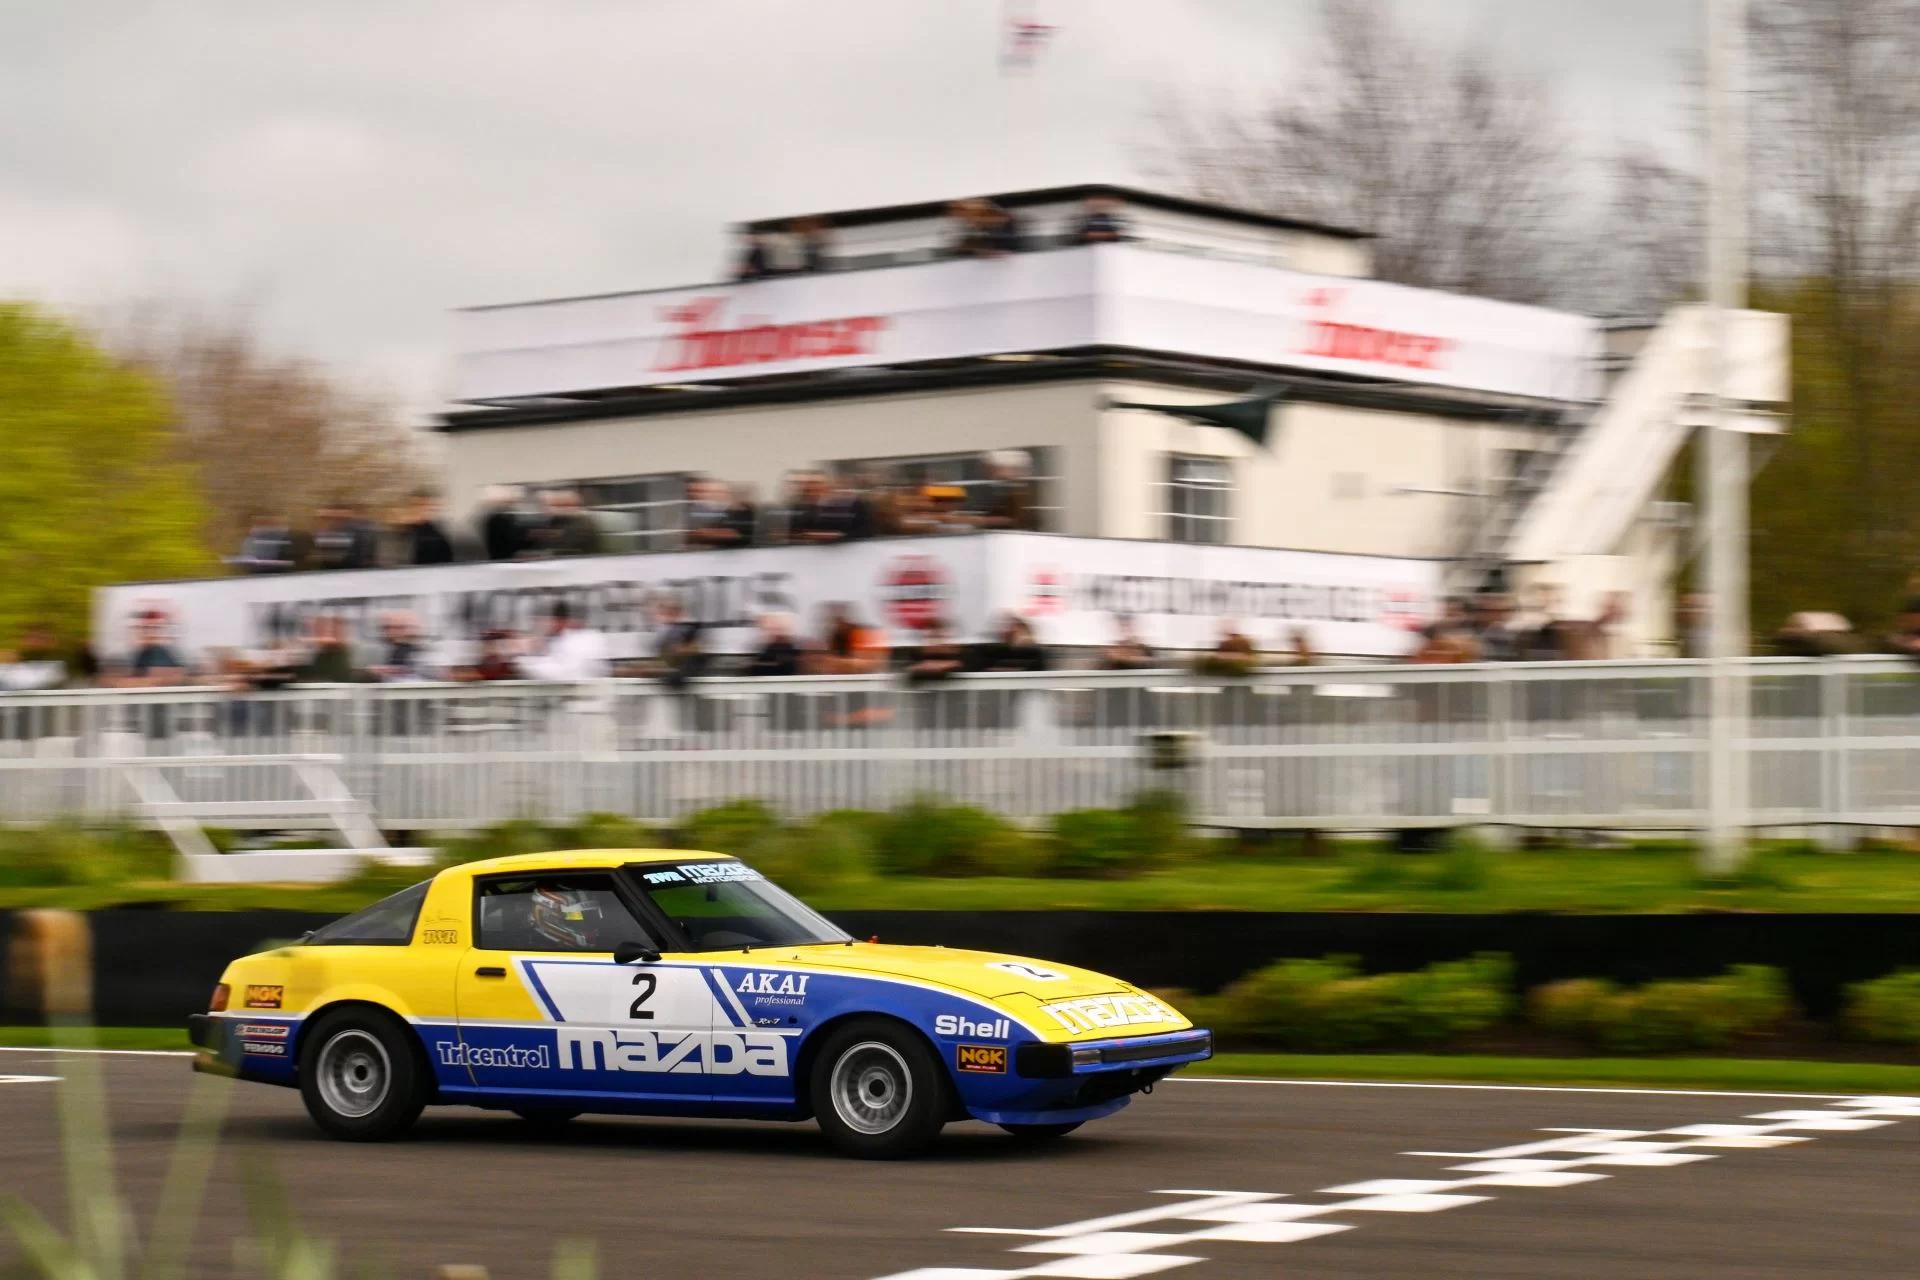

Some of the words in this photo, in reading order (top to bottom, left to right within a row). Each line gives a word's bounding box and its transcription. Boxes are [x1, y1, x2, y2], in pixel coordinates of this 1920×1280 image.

[424, 929, 457, 944] TWR
[1001, 963, 1055, 978] 2
[248, 985, 283, 1001] NGK
[737, 972, 809, 995] AKAI
[629, 973, 656, 1019] 2
[755, 995, 804, 1006] professional
[935, 1014, 1009, 1039] Shell
[436, 1041, 550, 1068] Tricentrol
[556, 1028, 789, 1077] mazda
[961, 1048, 1003, 1065] NGK
